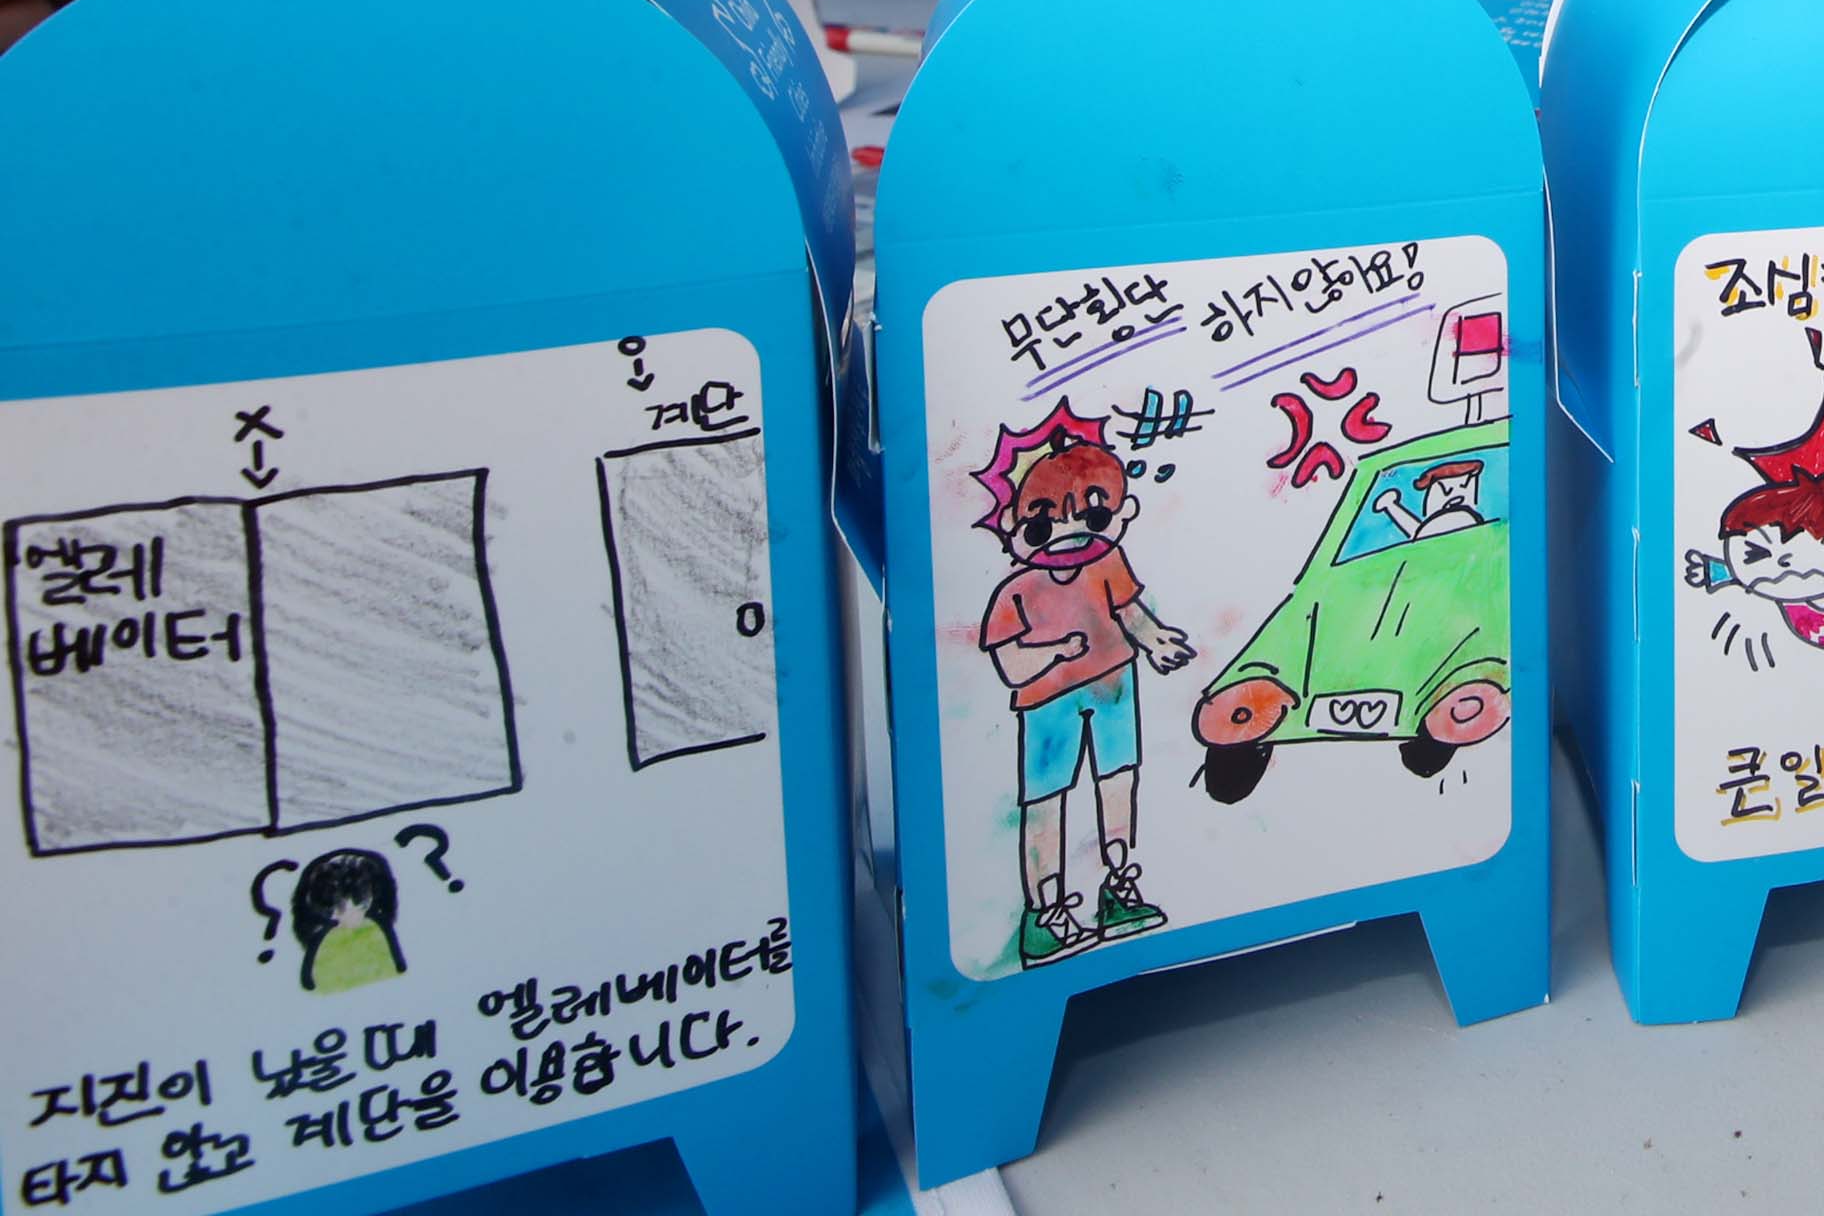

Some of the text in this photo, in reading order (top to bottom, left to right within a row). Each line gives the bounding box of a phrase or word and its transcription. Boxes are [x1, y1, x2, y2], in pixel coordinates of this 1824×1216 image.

[644, 380, 750, 432] 계단
[29, 1059, 212, 1128] 지진이
[21, 1148, 128, 1206] 타지
